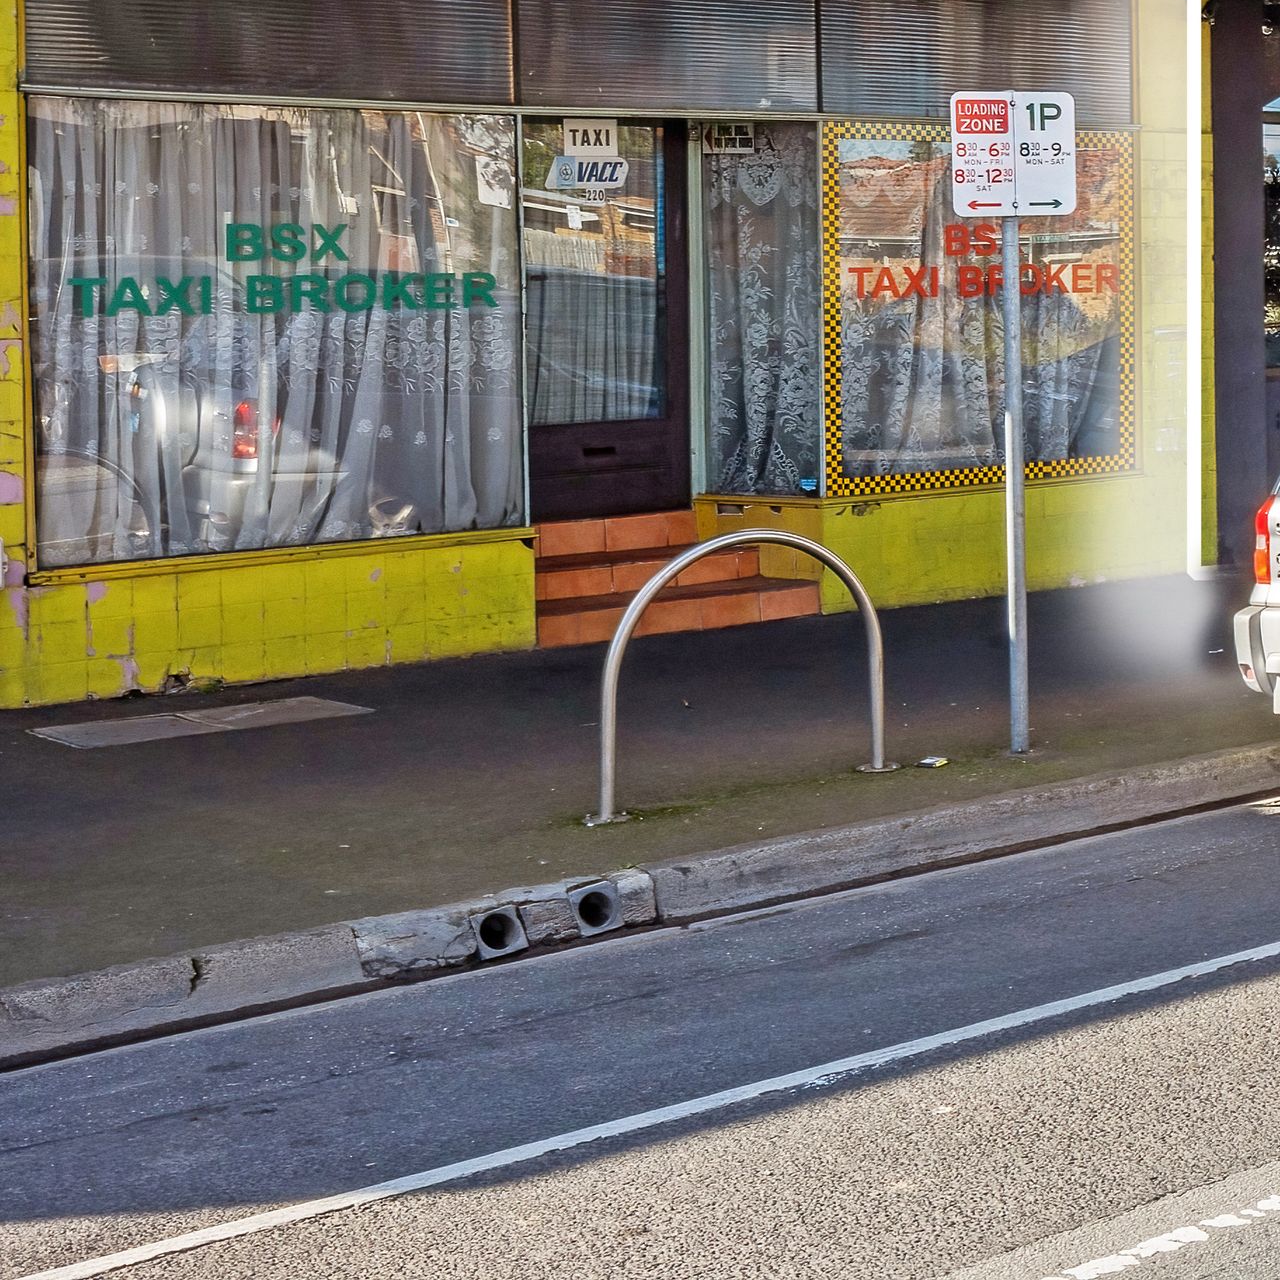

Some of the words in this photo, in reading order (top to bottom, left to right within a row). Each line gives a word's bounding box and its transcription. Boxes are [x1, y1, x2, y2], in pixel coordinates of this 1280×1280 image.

[958, 103, 1005, 115] LOADING
[1026, 103, 1062, 131] 1P
[960, 118, 1004, 131] ZONE
[570, 129, 610, 146] TAXI
[577, 162, 623, 182] VACC
[587, 190, 605, 201] 220
[226, 223, 348, 261] BSX
[944, 223, 1023, 256] BS
[67, 275, 212, 317] TAXI
[246, 271, 499, 314] BROKER
[848, 266, 940, 298] TAXI
